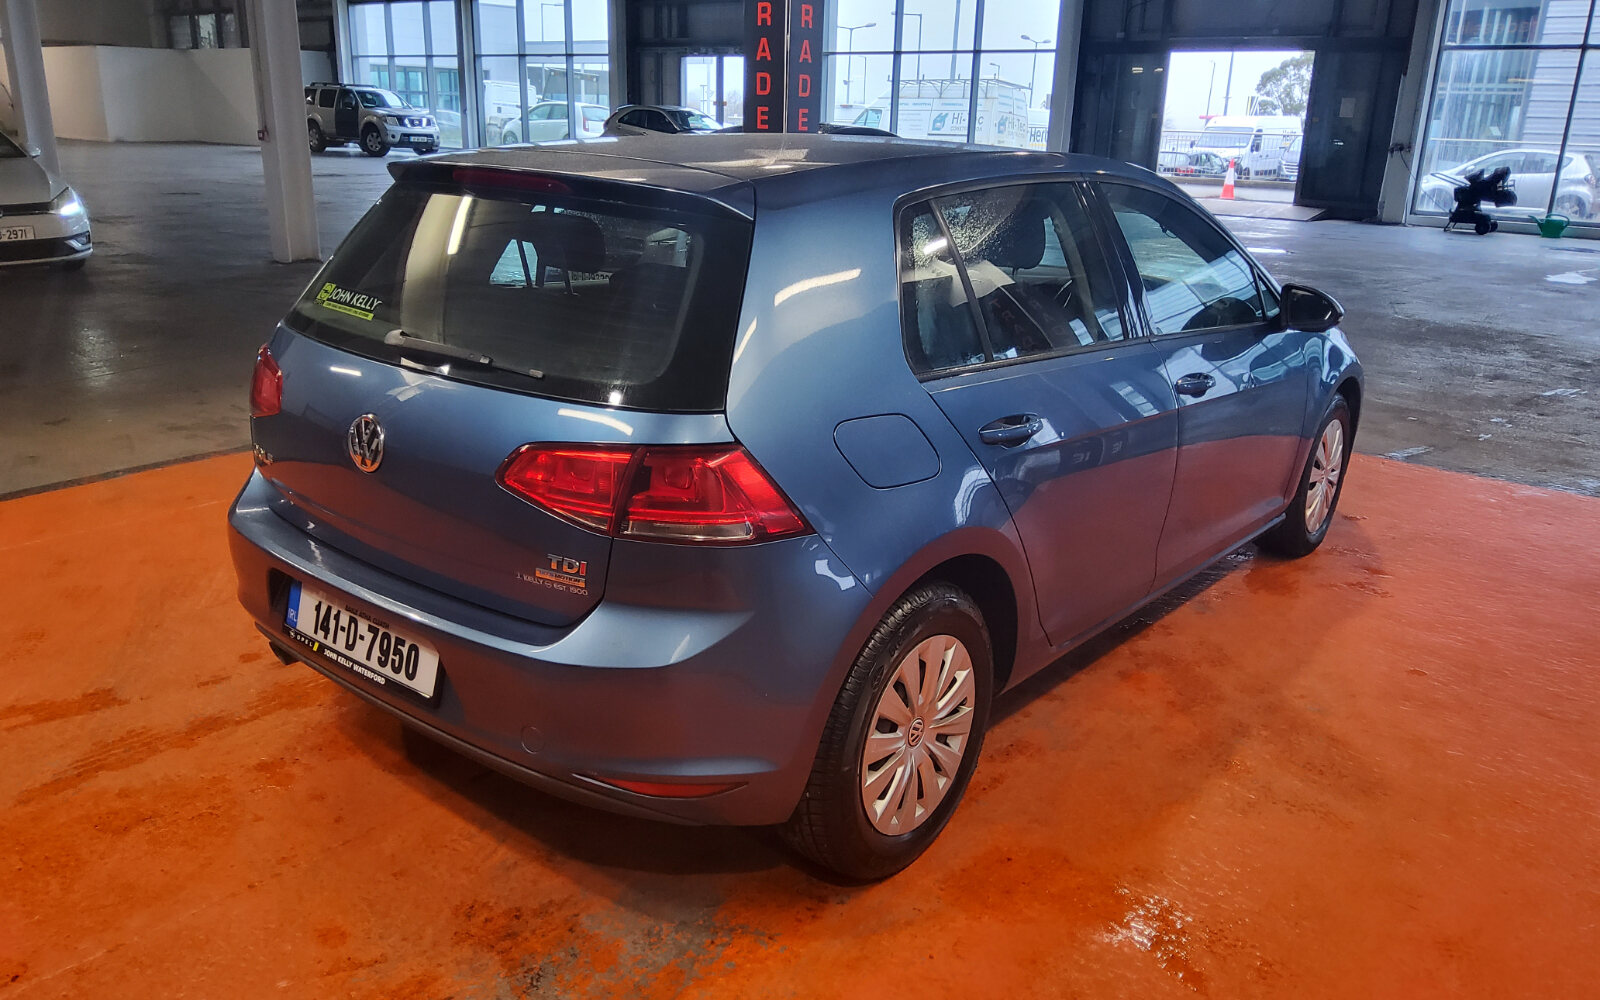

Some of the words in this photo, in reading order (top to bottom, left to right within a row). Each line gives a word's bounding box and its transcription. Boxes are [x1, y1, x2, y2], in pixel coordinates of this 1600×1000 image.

[329, 288, 355, 304] JOHN
[350, 293, 382, 310] KELLY
[547, 553, 587, 576] TDI
[569, 586, 588, 596] 1900
[287, 608, 298, 622] IRL
[313, 600, 420, 681] 141-D-7950
[296, 635, 313, 648] OPEL
[323, 648, 338, 661] JOHN
[337, 655, 354, 669] KELLY
[353, 663, 386, 685] WATERFORD
